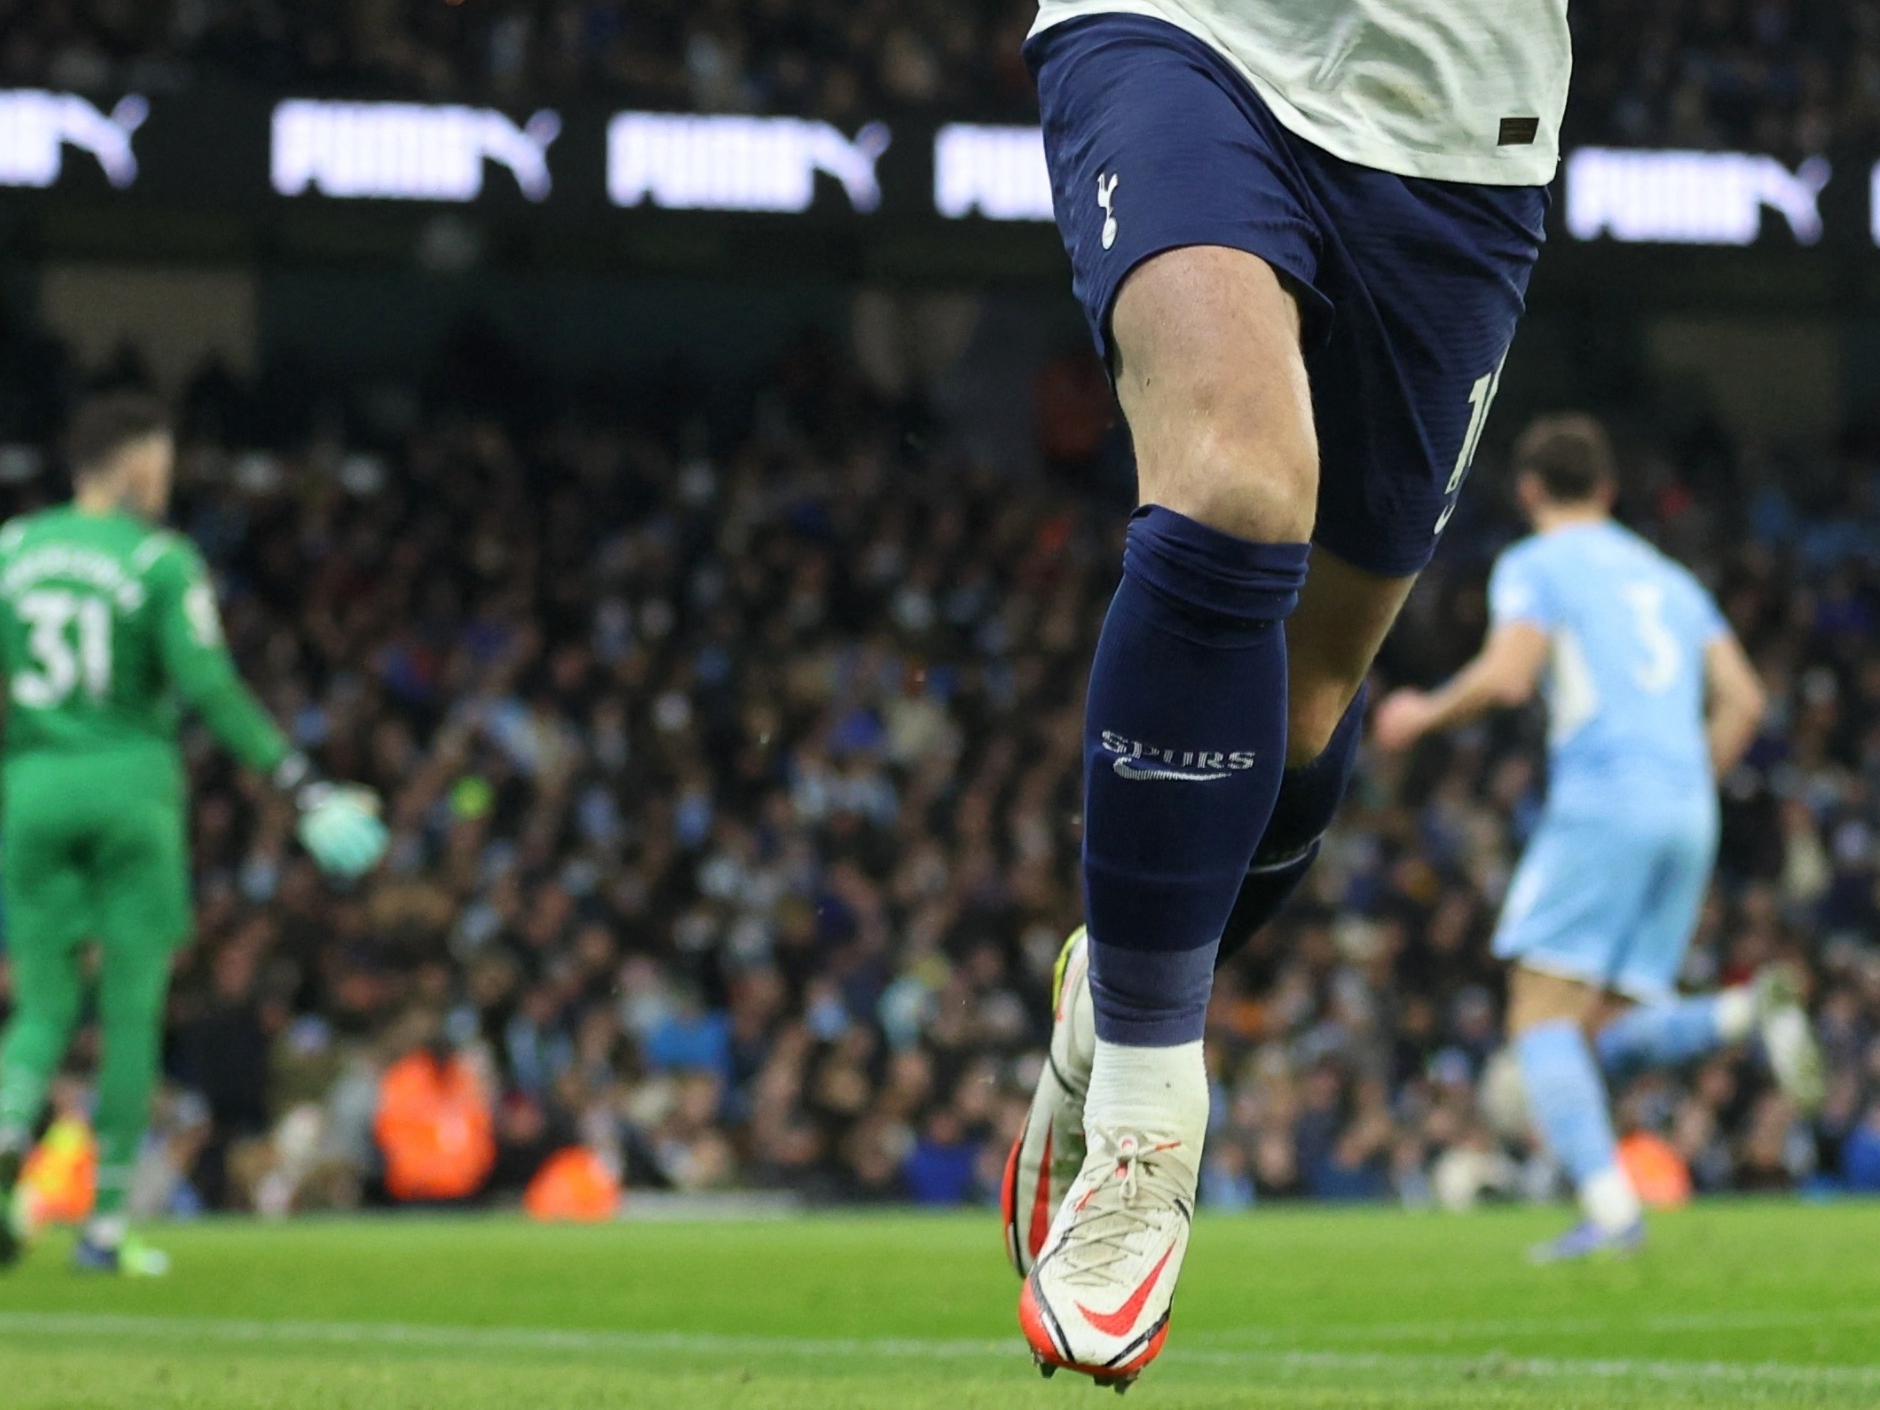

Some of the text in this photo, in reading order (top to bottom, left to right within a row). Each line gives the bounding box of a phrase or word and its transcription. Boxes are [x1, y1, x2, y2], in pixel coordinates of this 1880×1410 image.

[12, 589, 112, 709] 31
[1626, 580, 1682, 694] 3
[1101, 730, 1256, 769] SPURS
